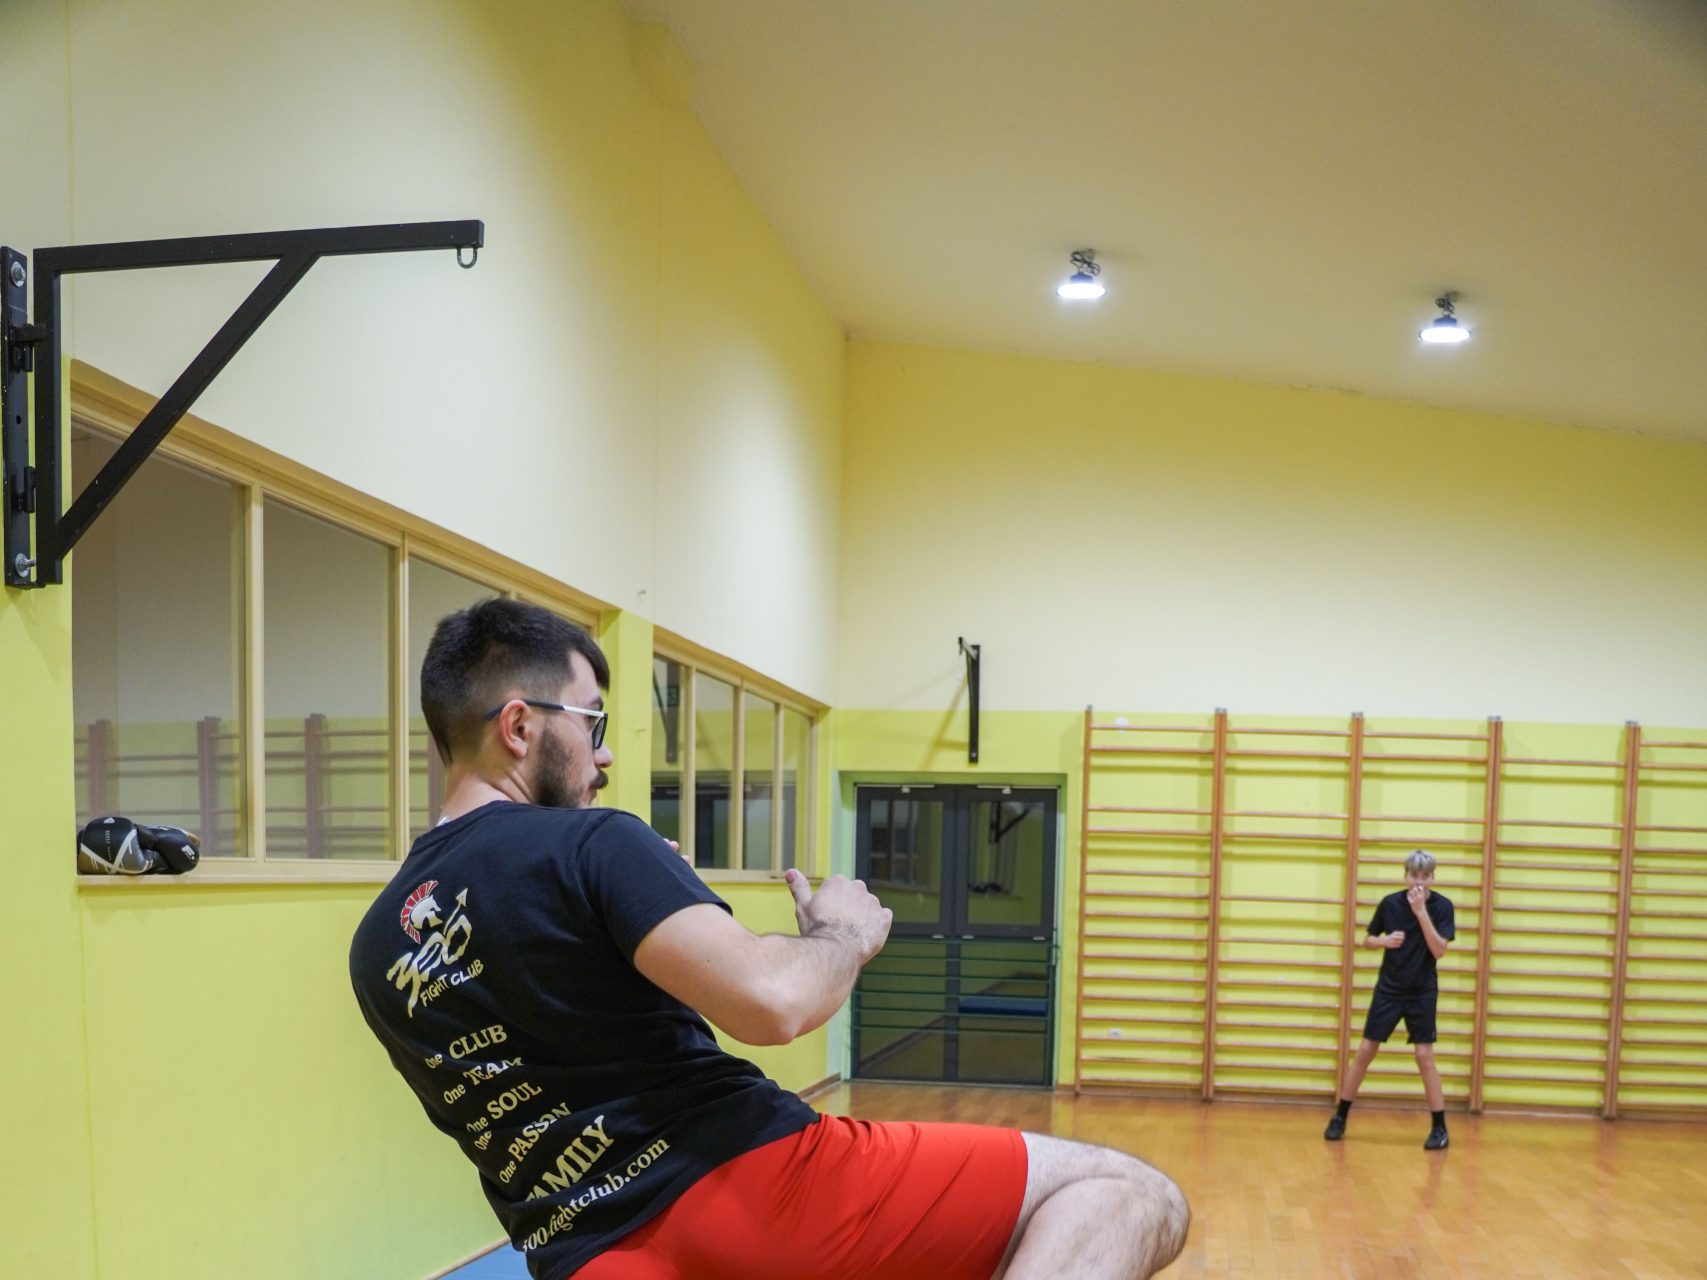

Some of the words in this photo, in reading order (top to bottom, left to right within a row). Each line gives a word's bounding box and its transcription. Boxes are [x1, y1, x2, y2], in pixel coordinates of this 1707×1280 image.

[420, 974, 450, 1007] FIGHT
[450, 959, 485, 986] CLUB
[425, 1053, 443, 1069] One
[449, 1024, 508, 1059] CLUB
[443, 1084, 466, 1104] One
[463, 1057, 525, 1086] TEAM
[487, 1082, 543, 1119] SOUL
[500, 1160, 517, 1183] One
